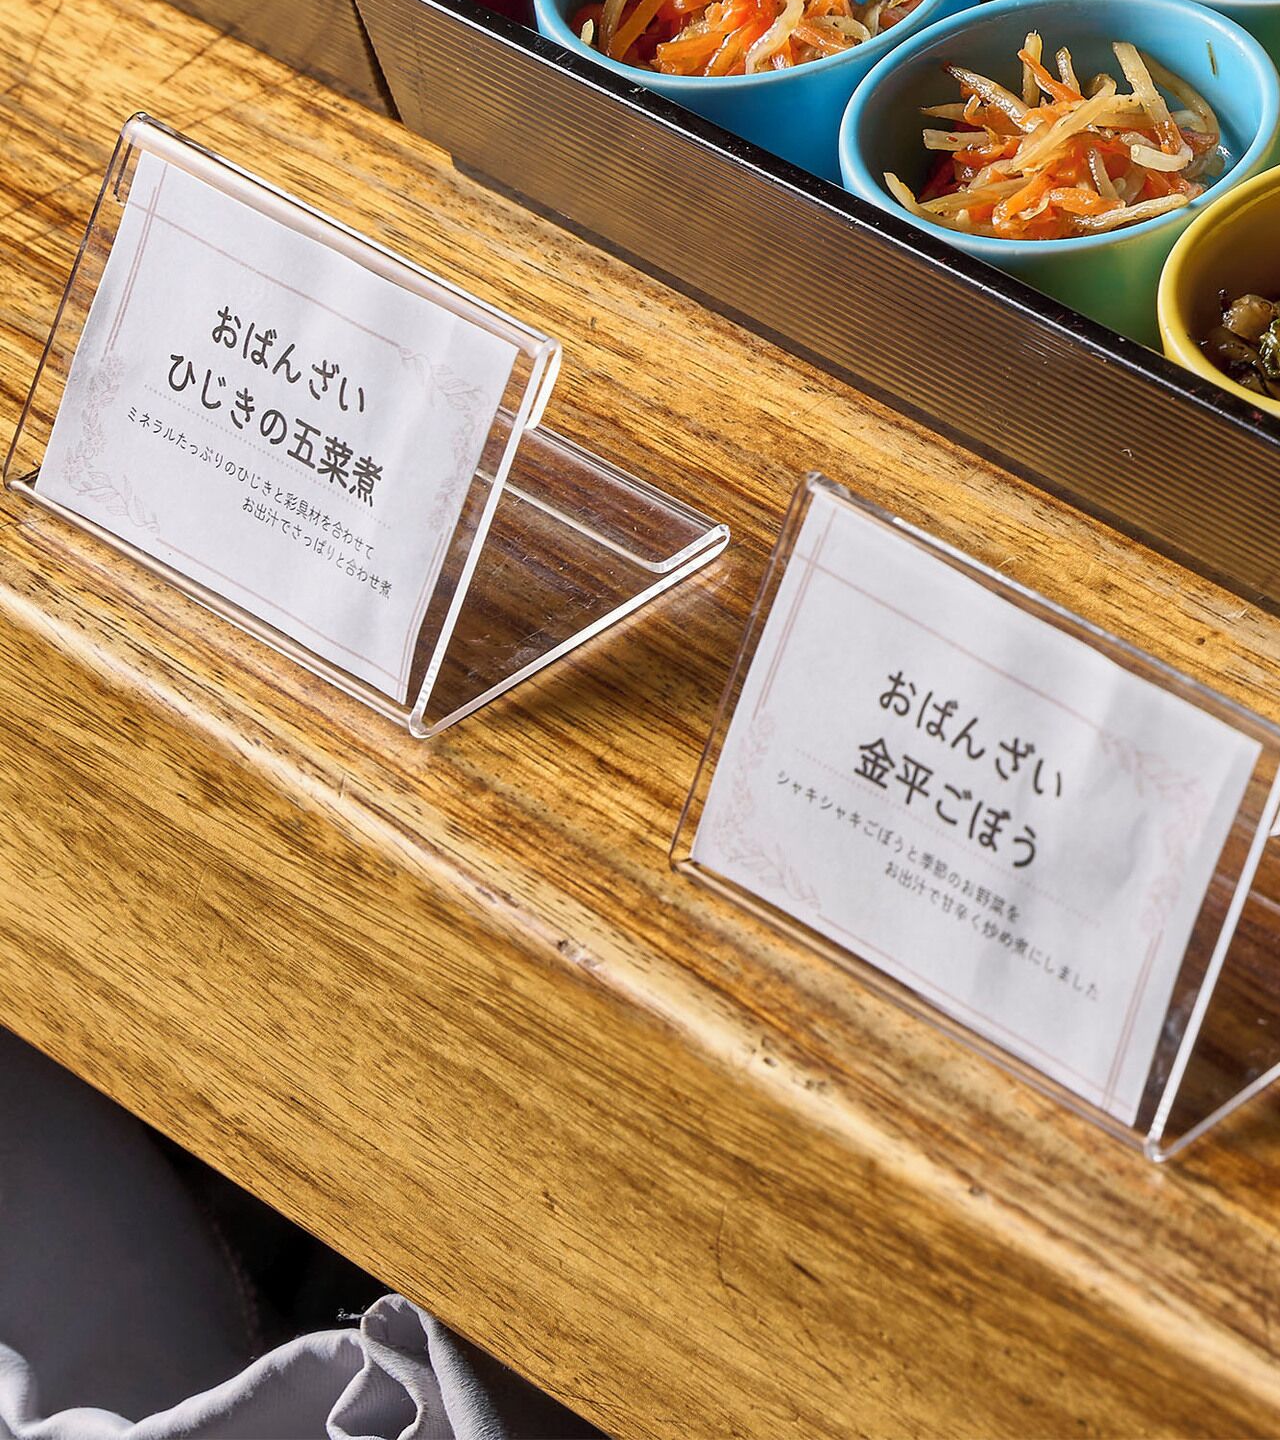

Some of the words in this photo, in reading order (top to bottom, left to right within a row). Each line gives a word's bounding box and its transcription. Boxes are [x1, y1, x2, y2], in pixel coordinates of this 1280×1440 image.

[211, 305, 366, 415] おばんざい
[167, 353, 385, 509] ひじきの五菜煮
[878, 670, 1064, 799] おばんざい
[853, 738, 1038, 870] 金平ごぼう
